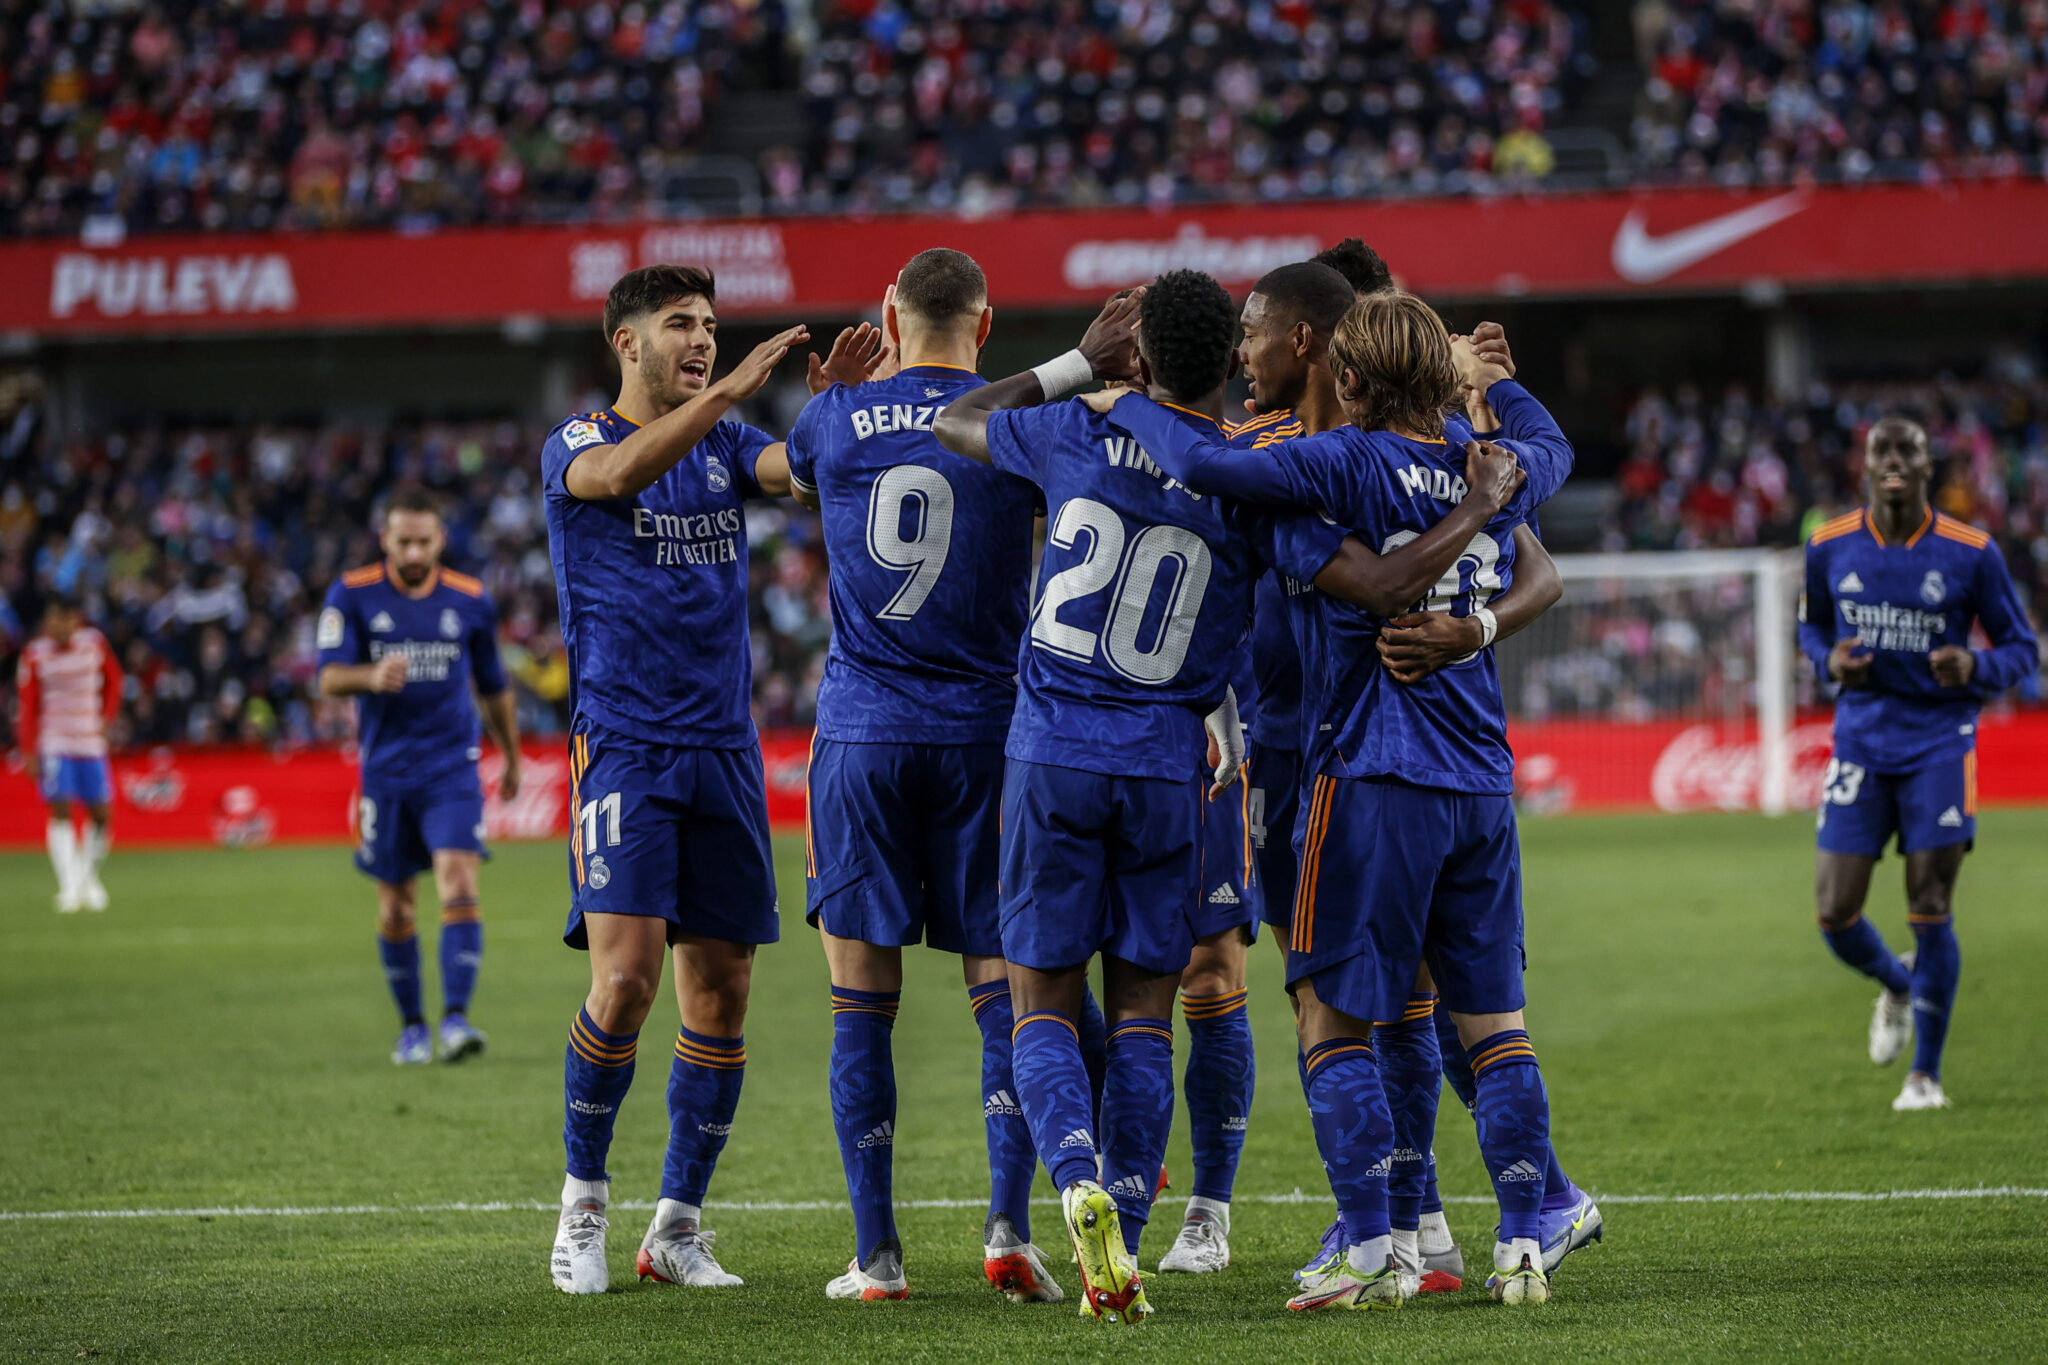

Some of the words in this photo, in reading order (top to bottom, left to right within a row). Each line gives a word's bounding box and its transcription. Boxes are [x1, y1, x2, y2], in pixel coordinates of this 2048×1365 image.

[51, 253, 296, 317] PULEVA
[656, 542, 681, 565] FLY
[682, 538, 738, 565] BETTER
[866, 465, 955, 621] 9
[1031, 497, 1213, 685] 20
[1840, 599, 1946, 634] Emirates
[580, 792, 621, 855] 11
[1209, 896, 1240, 904] adidas
[984, 1104, 1022, 1118] adidas
[1391, 1153, 1422, 1162] ADRID
[1498, 1173, 1543, 1182] adidas
[1107, 1184, 1150, 1201] adidas
